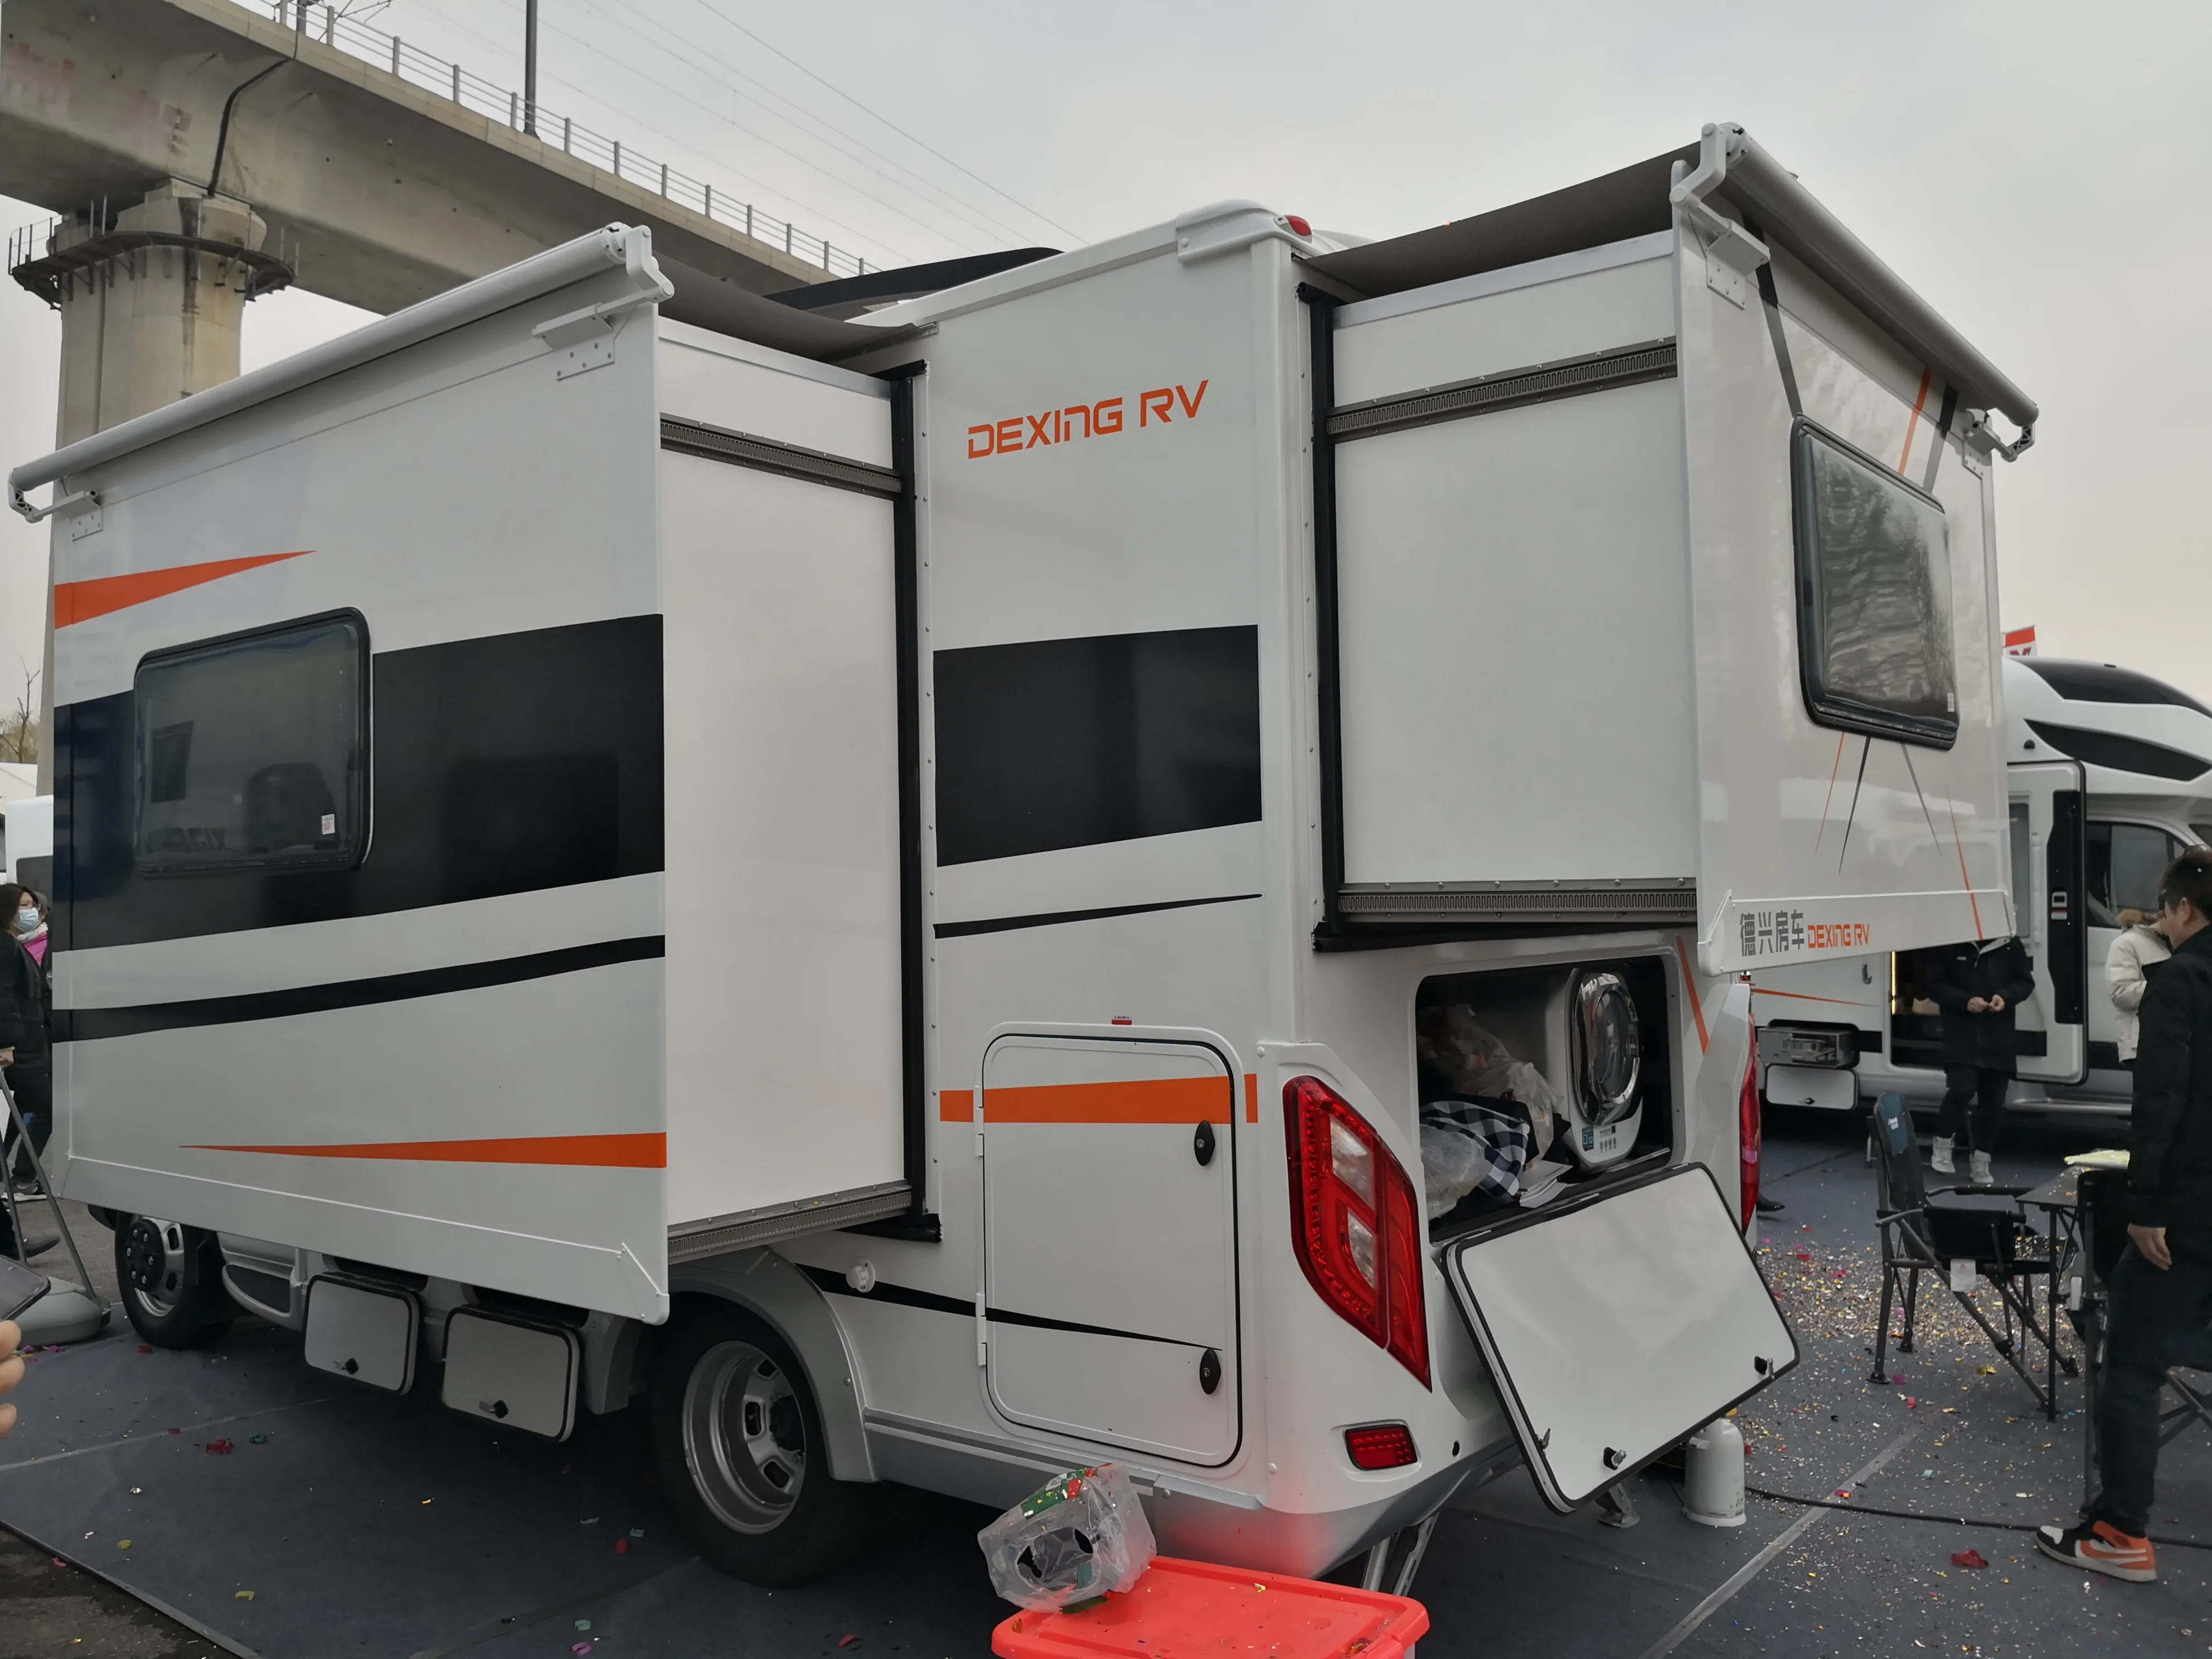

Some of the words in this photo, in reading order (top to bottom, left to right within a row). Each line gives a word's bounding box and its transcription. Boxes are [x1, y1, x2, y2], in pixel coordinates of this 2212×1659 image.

[968, 397, 1123, 459] DEXING
[1140, 379, 1209, 428] RV
[1740, 909, 1805, 957] 德兴房车
[1807, 924, 1851, 948] DEXING
[1854, 923, 1870, 946] RV
